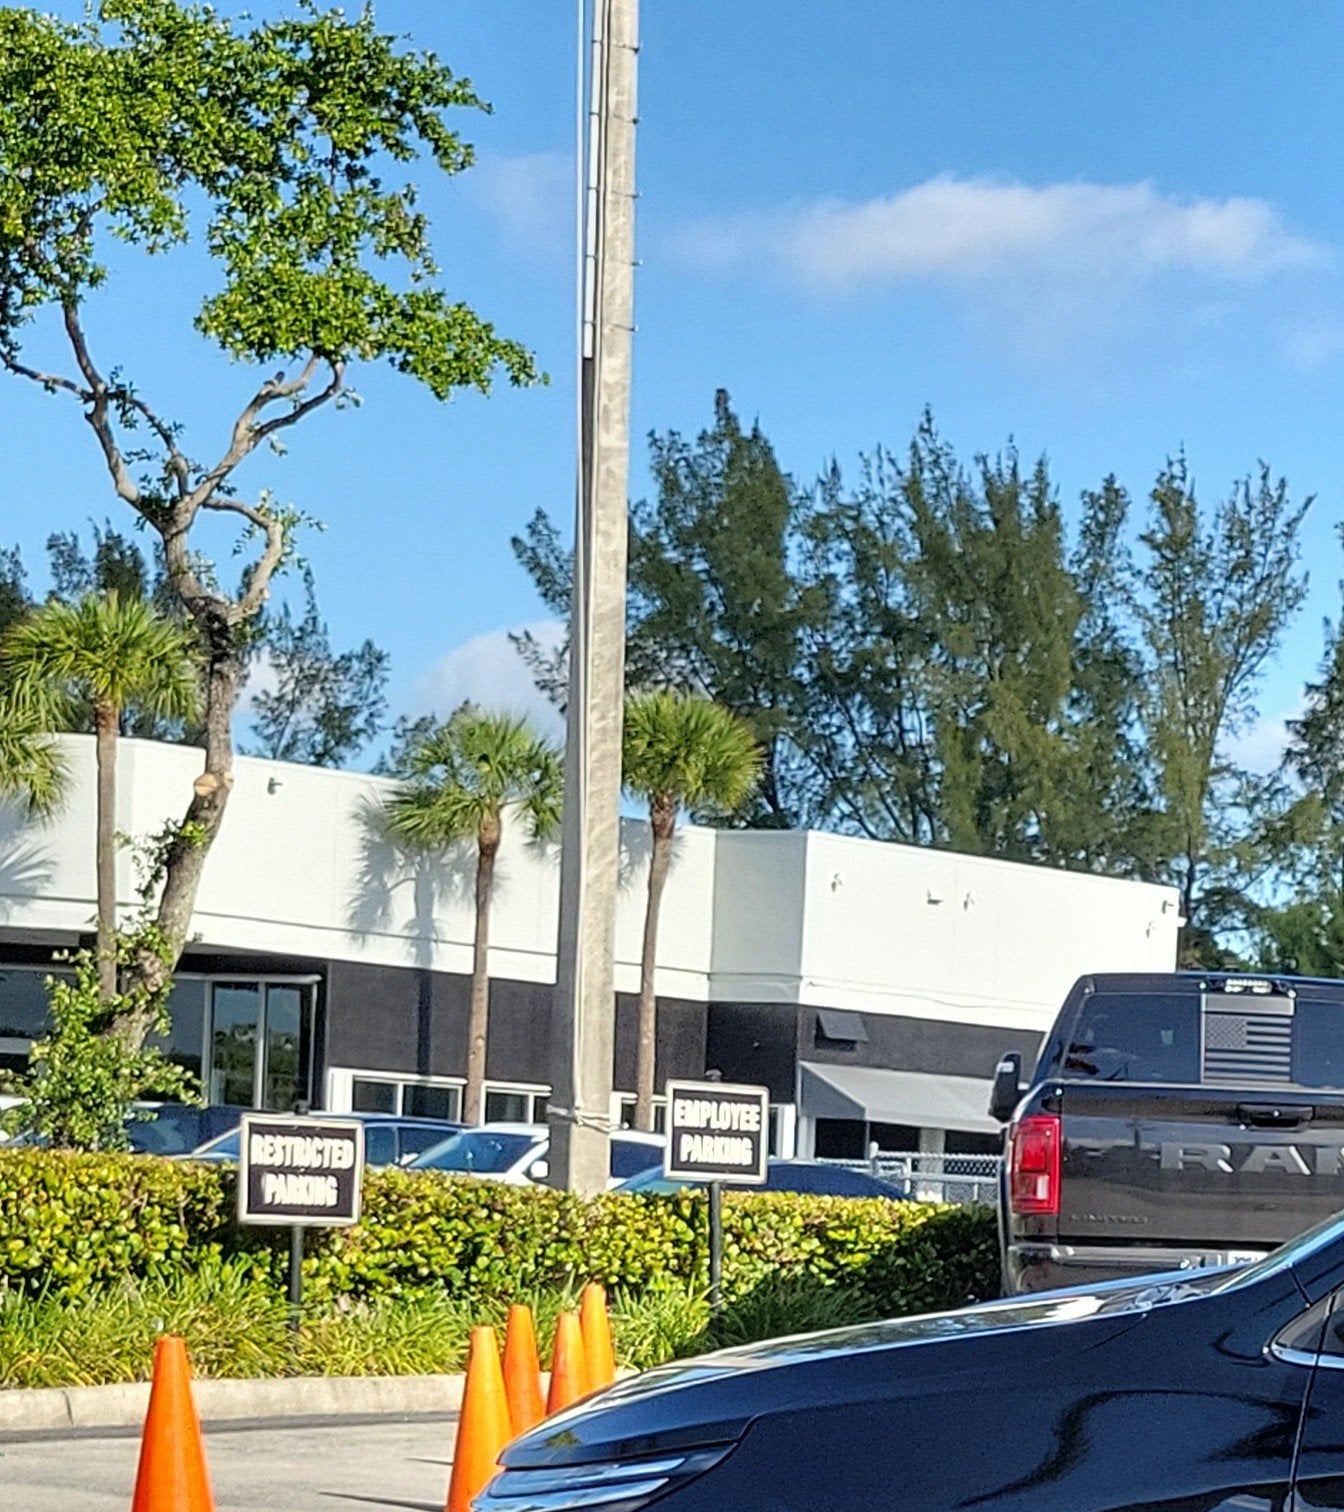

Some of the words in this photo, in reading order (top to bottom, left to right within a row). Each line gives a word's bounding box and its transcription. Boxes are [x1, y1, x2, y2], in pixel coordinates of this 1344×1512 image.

[673, 1098, 761, 1132] EMPLOYEE
[250, 1133, 355, 1170] RESTRICTED
[680, 1133, 753, 1166] PARKING
[262, 1172, 338, 1207] PARKING
